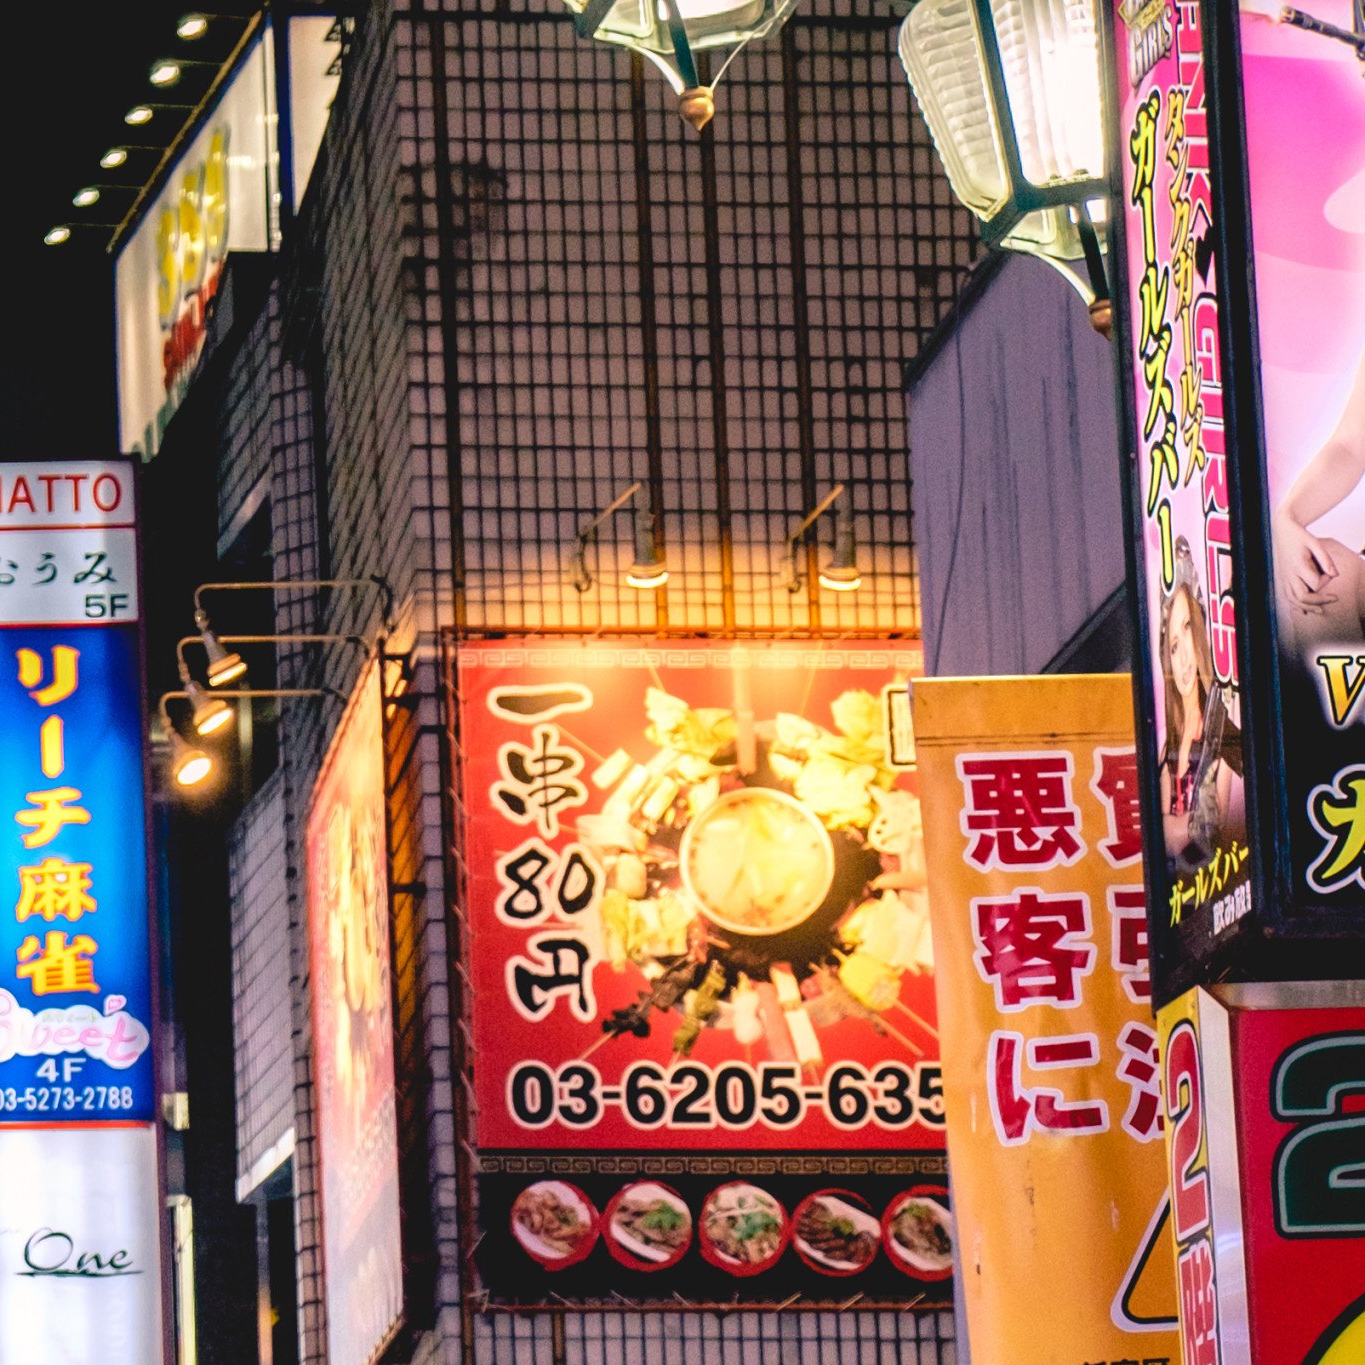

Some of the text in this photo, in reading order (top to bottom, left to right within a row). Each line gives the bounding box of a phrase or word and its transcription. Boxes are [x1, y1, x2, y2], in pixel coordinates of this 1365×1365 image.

[1129, 86, 1178, 597] ガールズバー
[85, 594, 129, 619] 5F
[15, 645, 99, 997] リーチ麻雀
[36, 1058, 83, 1084] 4F
